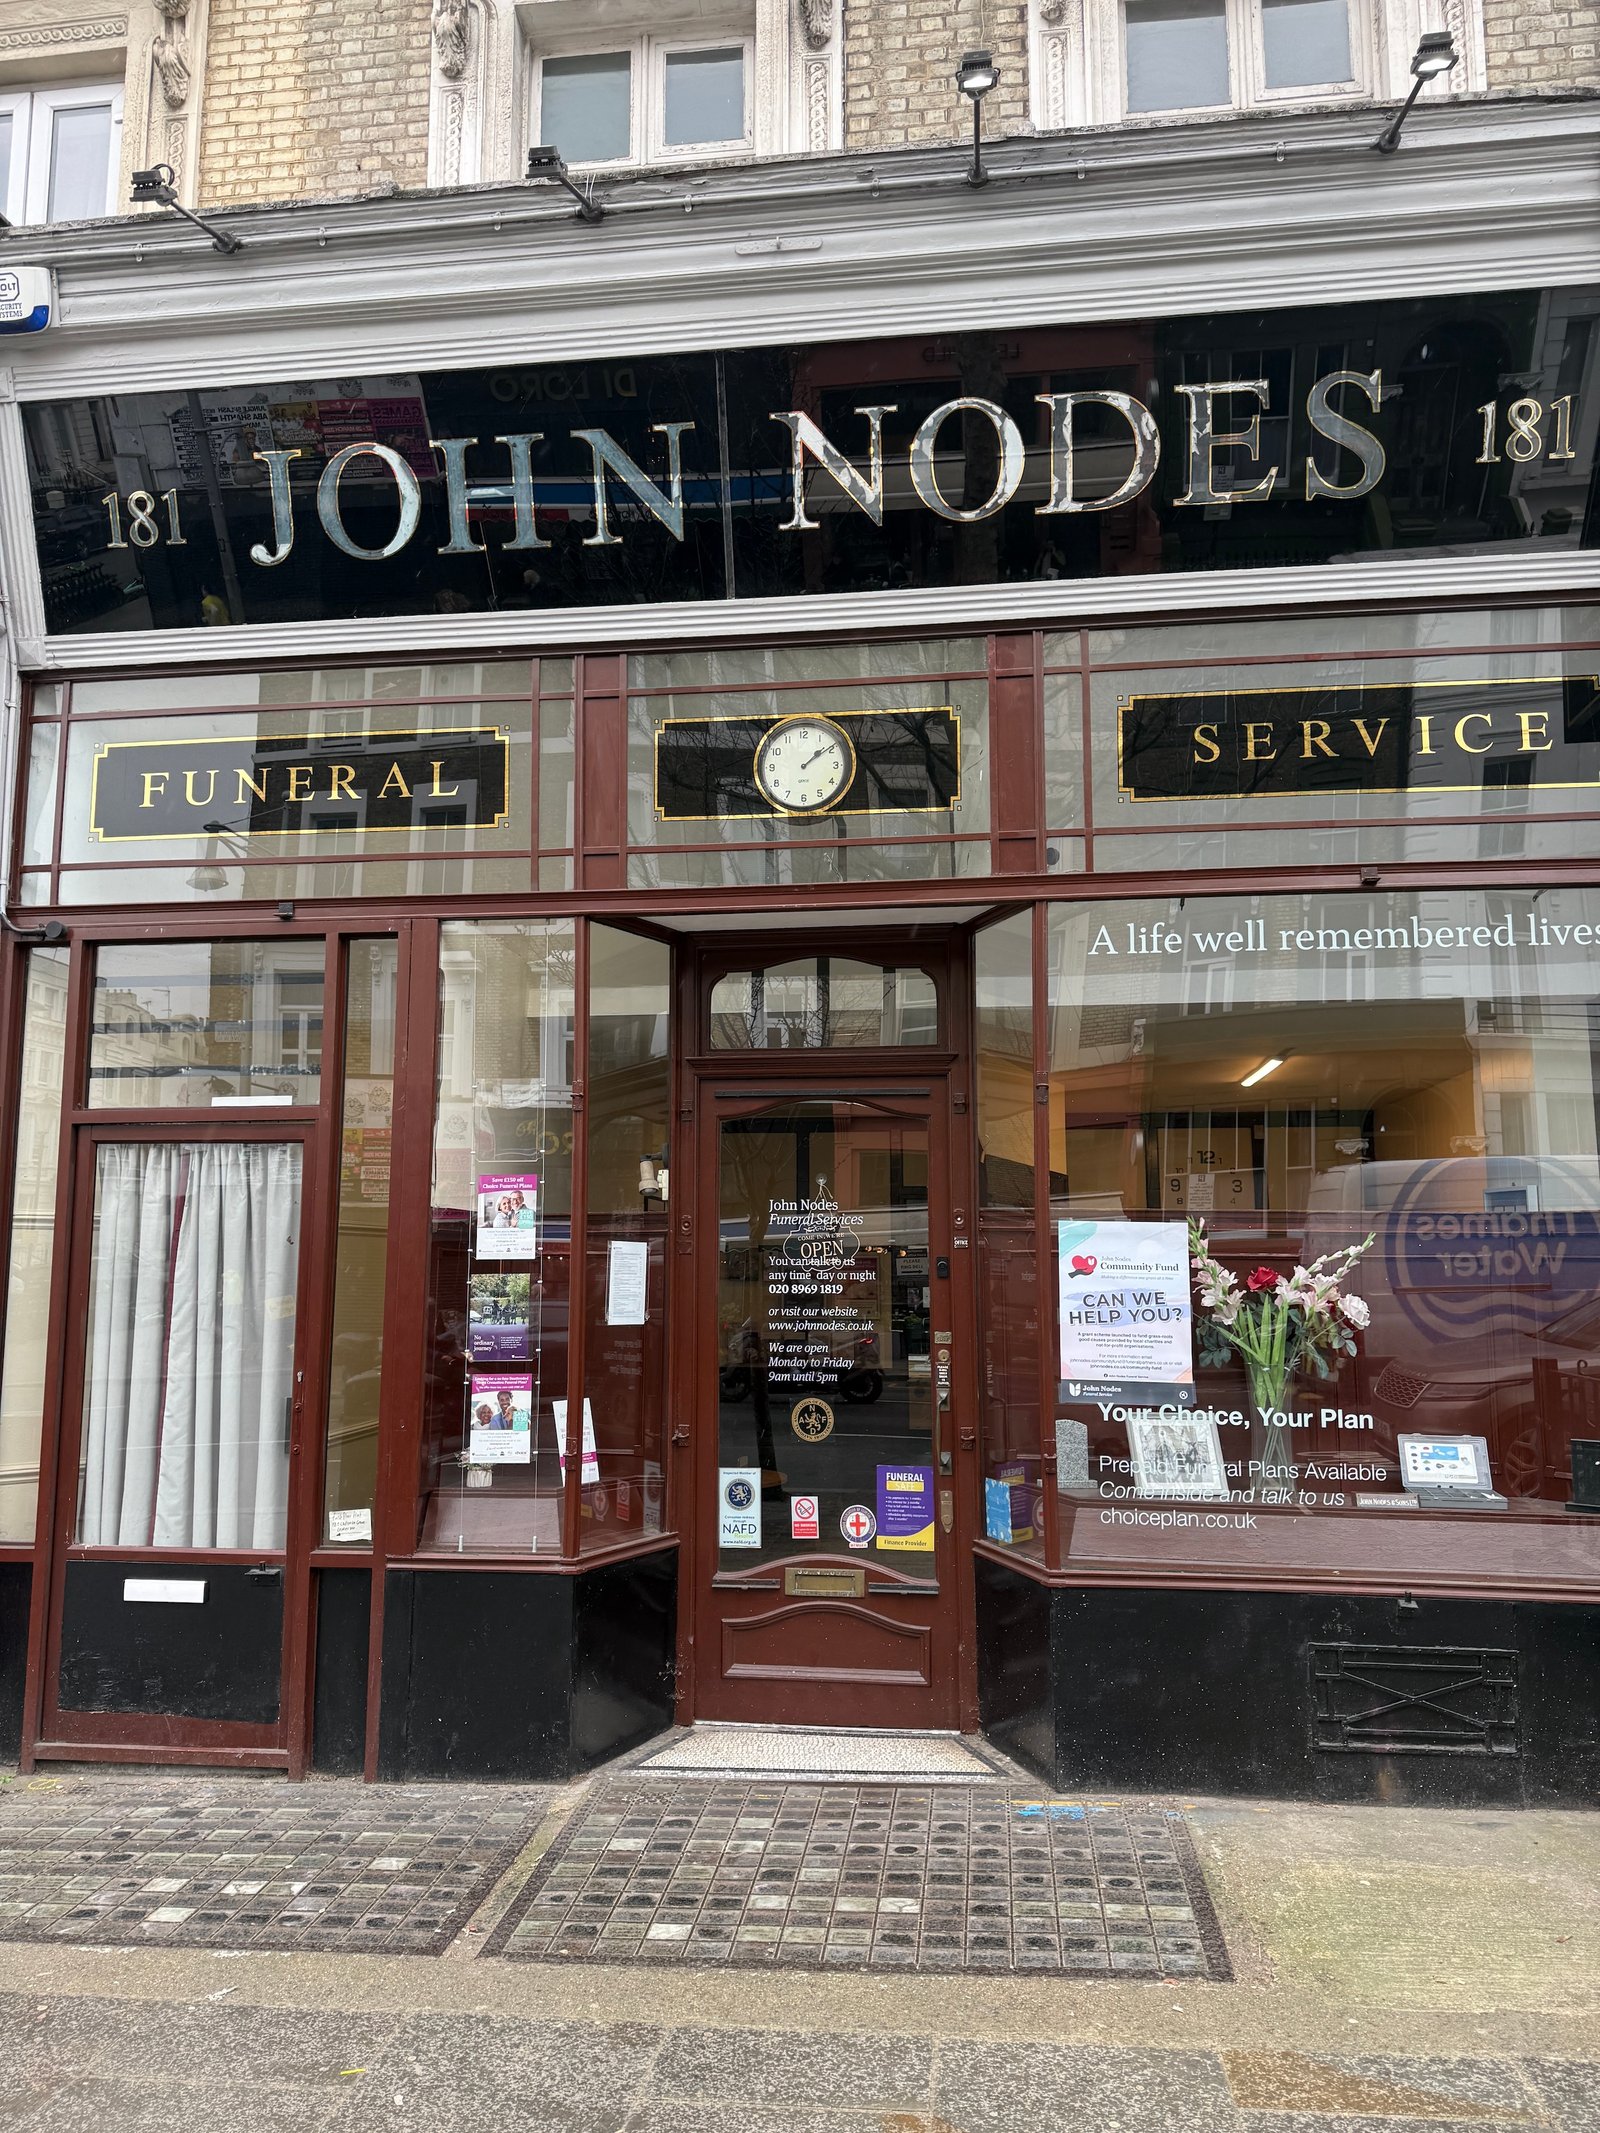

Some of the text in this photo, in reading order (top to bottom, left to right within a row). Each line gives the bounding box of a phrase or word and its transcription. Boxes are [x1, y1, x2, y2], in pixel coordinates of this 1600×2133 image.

[0, 282, 16, 291] OLT
[1476, 395, 1577, 464] 181
[249, 421, 697, 568] JOHN
[769, 368, 1387, 532] NODES
[101, 488, 189, 549] 181
[784, 736, 791, 744] 11
[799, 730, 808, 739] 12
[1193, 711, 1554, 764] SERVICE
[772, 748, 782, 756] 10
[768, 764, 776, 772] 9
[832, 762, 839, 770] 3
[138, 761, 460, 808] FUNERAL
[773, 779, 780, 788] 8
[828, 778, 835, 786] 4
[784, 790, 791, 799] 7
[800, 794, 807, 803] 6
[816, 789, 823, 798] 5
[1087, 928, 1119, 956] A
[1126, 921, 1183, 954] life
[1192, 919, 1267, 953] well
[1278, 913, 1516, 950] remembered
[1197, 1150, 1216, 1164] 12
[1170, 1178, 1181, 1192] 9
[1231, 1179, 1243, 1194] 3
[769, 1199, 838, 1213] John Nodes
[768, 1213, 864, 1226] Funeral Services
[798, 1234, 815, 1242] COME
[800, 1239, 845, 1259] OPEN
[768, 1256, 788, 1266] You
[791, 1258, 808, 1266] can
[810, 1256, 830, 1266] talk
[844, 1258, 856, 1266] us
[1100, 1262, 1179, 1272] Community Fund
[768, 1270, 876, 1282] any time day or night
[768, 1284, 844, 1294] 020 8969 1819
[1082, 1291, 1166, 1308] CAN WE
[768, 1306, 858, 1316] or visit our website
[1068, 1306, 1184, 1326] HELP YOU?
[768, 1320, 874, 1332] www.johnnodes.co.uk
[768, 1342, 828, 1355] We are open
[768, 1357, 854, 1370] Monday to Friday
[768, 1372, 838, 1384] 9am until 5pm
[810, 1404, 816, 1412] N
[798, 1416, 805, 1424] A
[821, 1416, 827, 1424] F
[1097, 1401, 1374, 1430] Your Choice, Your Plan
[1099, 1455, 1387, 1482] Prepaid Funeral Plans Available
[886, 1472, 924, 1482] FUNERAL
[1099, 1481, 1345, 1506] Come inside and talk to us
[1100, 1507, 1257, 1530] choiceplan.co.uk
[722, 1523, 757, 1534] NAFD
